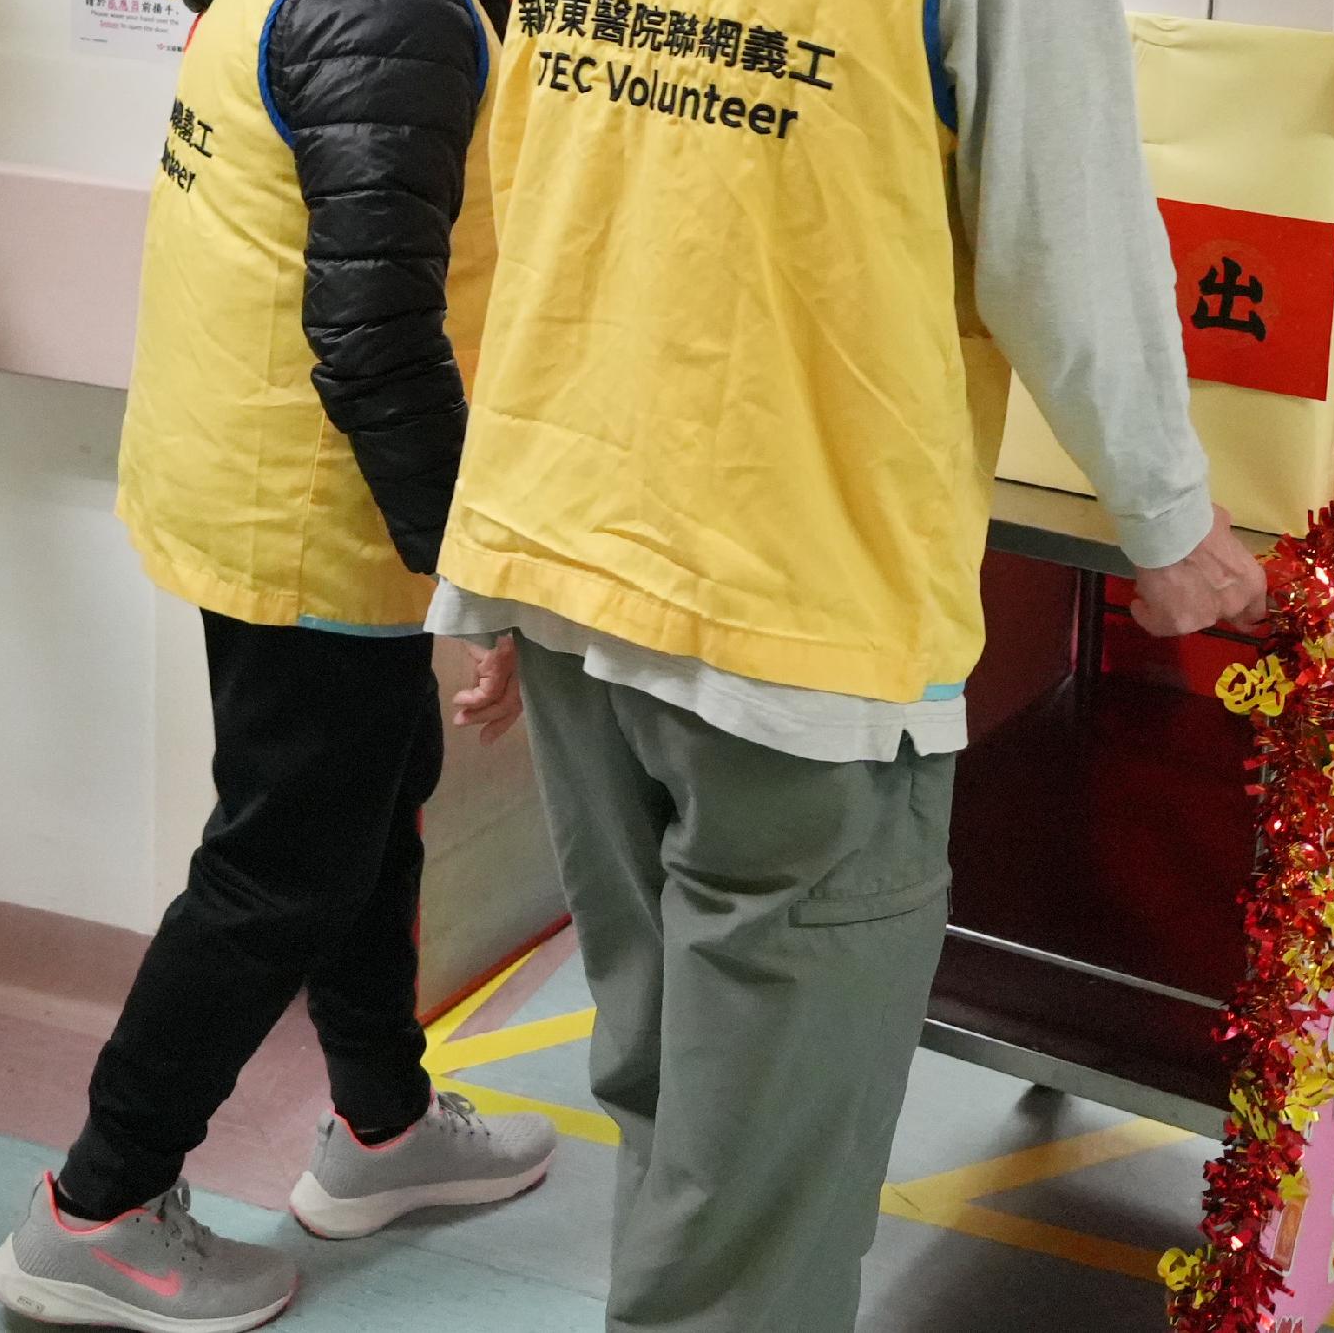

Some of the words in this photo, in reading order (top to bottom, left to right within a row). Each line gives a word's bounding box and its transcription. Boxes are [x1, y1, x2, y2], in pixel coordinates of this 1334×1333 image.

[538, 51, 597, 94] TEC
[606, 60, 798, 139] Volunteer
[1191, 256, 1266, 342] 出
